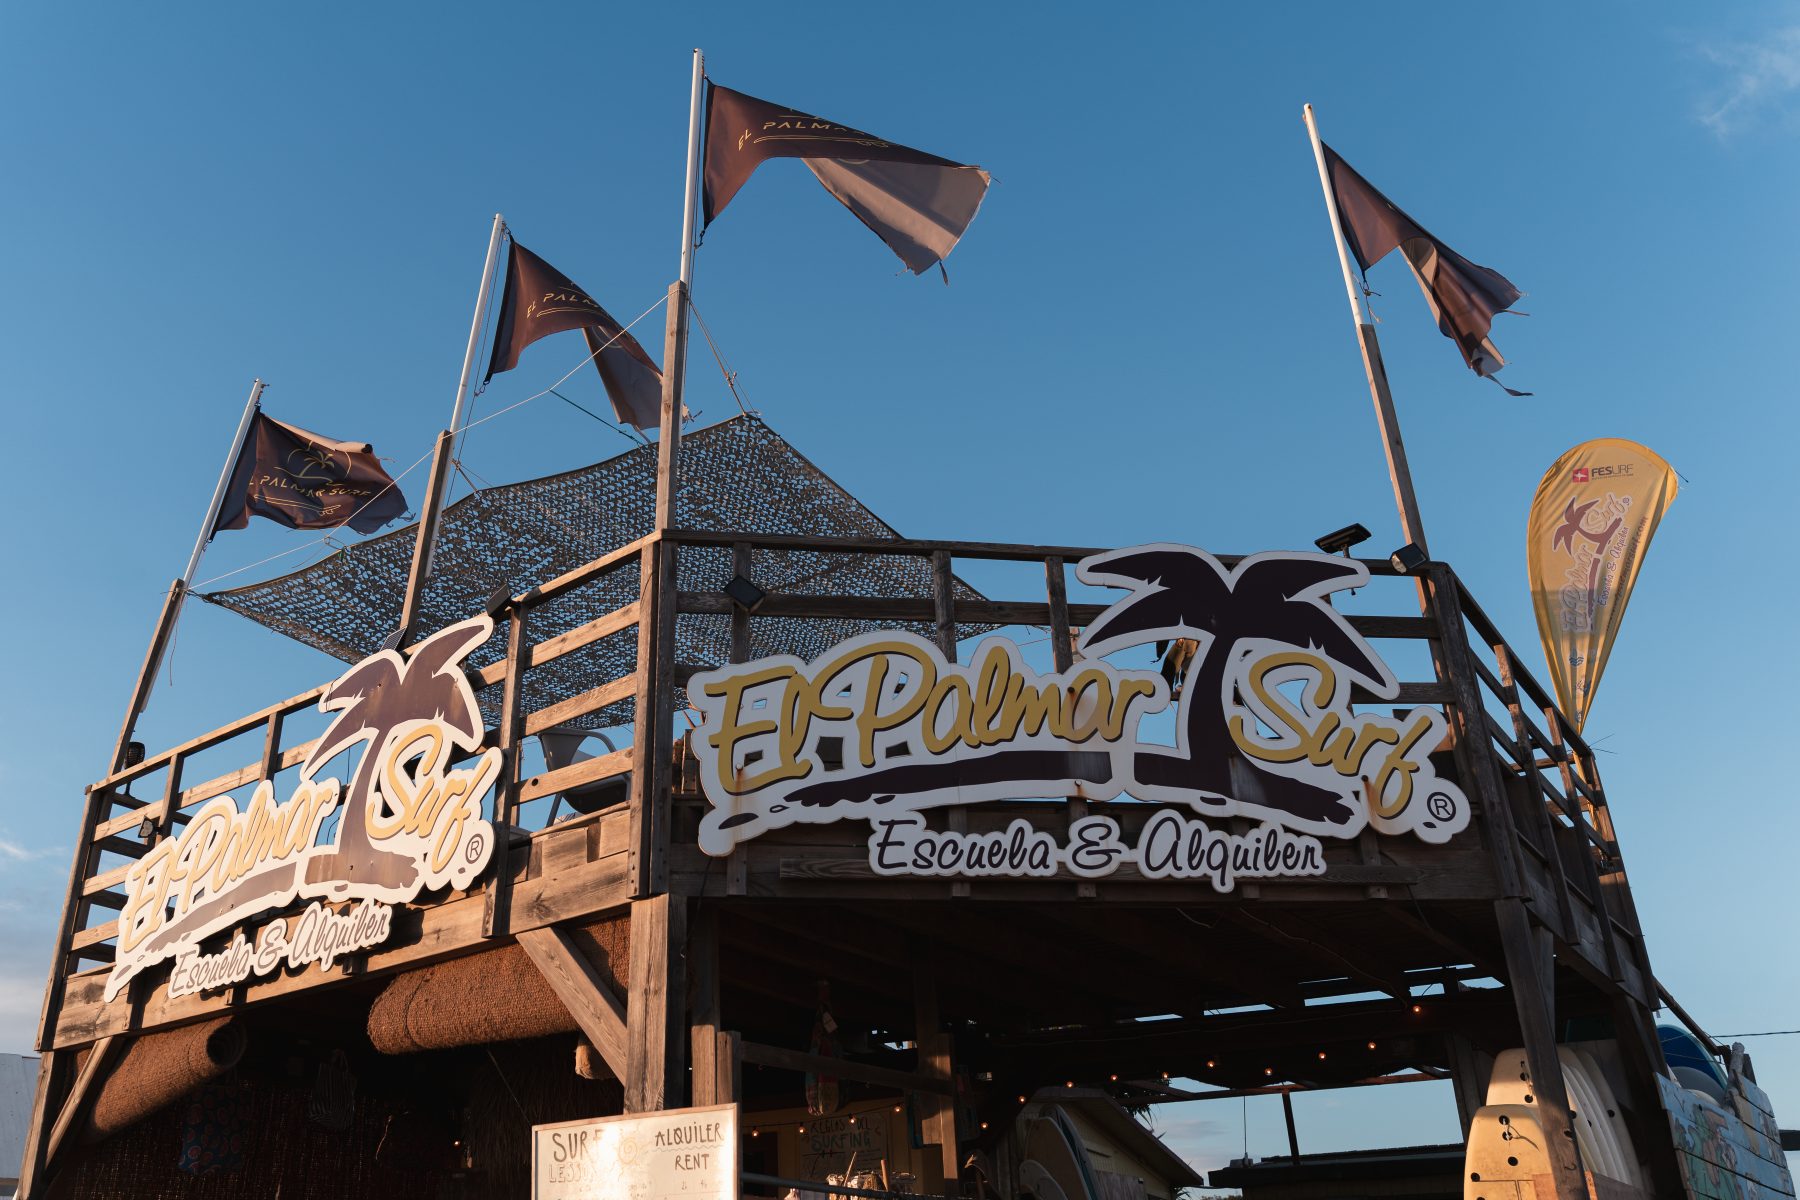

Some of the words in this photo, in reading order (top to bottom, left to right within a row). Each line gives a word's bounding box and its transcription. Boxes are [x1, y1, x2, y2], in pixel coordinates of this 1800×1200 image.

[1592, 464, 1634, 477] FESURF
[704, 665, 813, 794] El
[811, 641, 1156, 767] Palmar
[1229, 652, 1433, 819] Surf
[124, 853, 170, 952] El
[170, 787, 332, 912] Palmar
[365, 724, 493, 873] Surf
[877, 818, 1051, 871] Escuela
[1074, 822, 1120, 871] &
[1144, 816, 1320, 886] Alquiler
[172, 945, 250, 993] Escuela
[256, 924, 284, 969] &
[292, 904, 387, 965] Alquiler
[675, 1153, 709, 1171] RENT
[811, 1133, 872, 1151] SURFING
